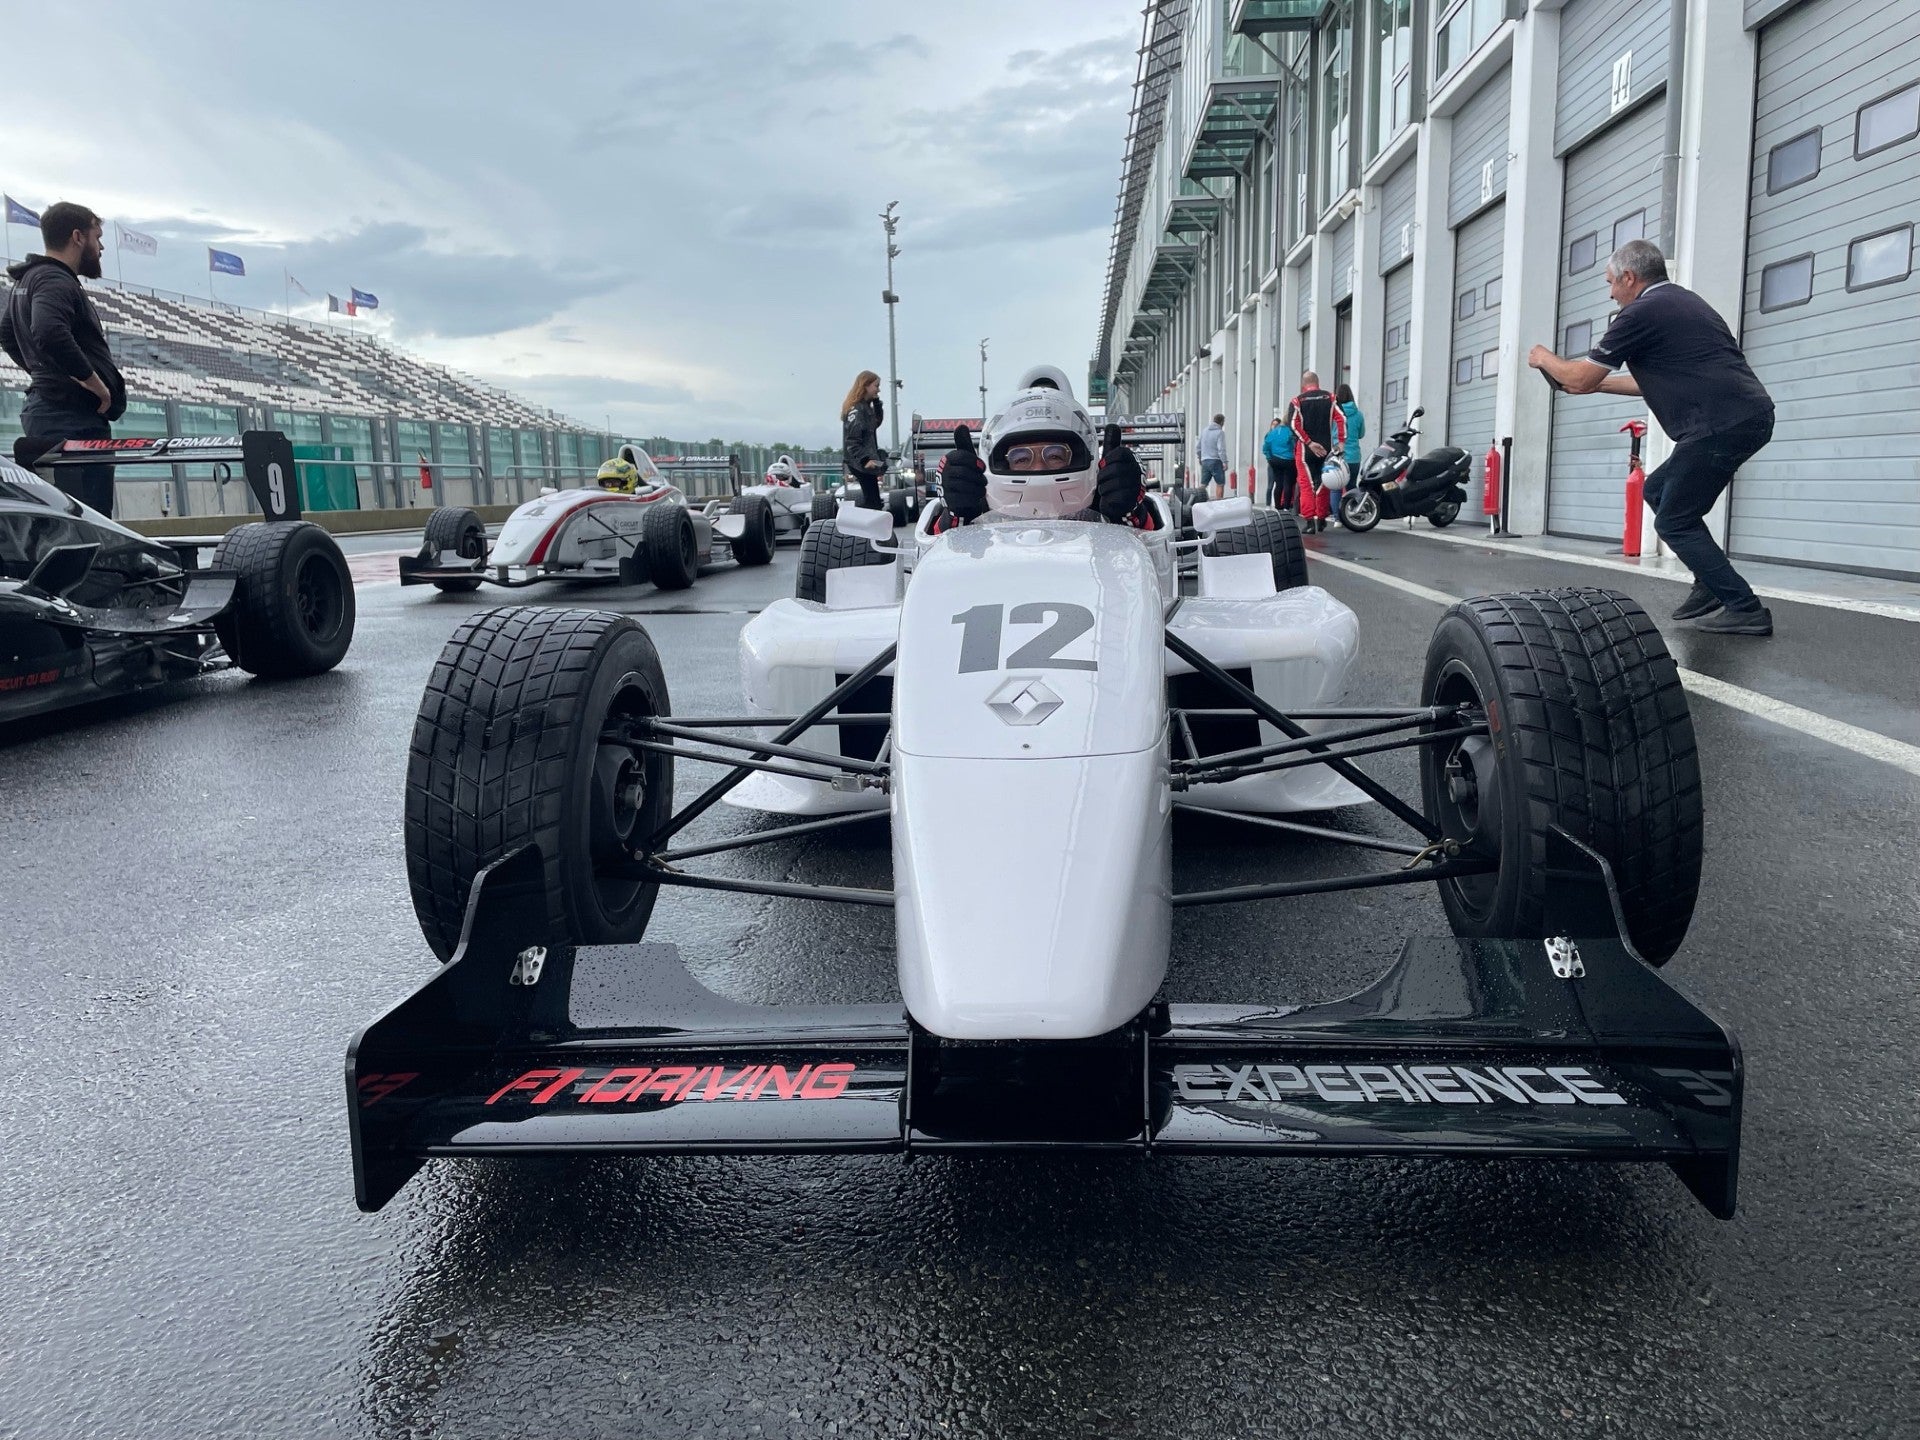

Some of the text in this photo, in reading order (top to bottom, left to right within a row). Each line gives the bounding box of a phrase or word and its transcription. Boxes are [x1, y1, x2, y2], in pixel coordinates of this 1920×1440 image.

[1613, 56, 1630, 106] 44
[267, 462, 287, 515] 9
[523, 506, 548, 517] 4
[951, 602, 1098, 674] 12
[485, 1063, 855, 1105] F1 DRIVING
[1173, 1064, 1627, 1104] EXPERIENCE
